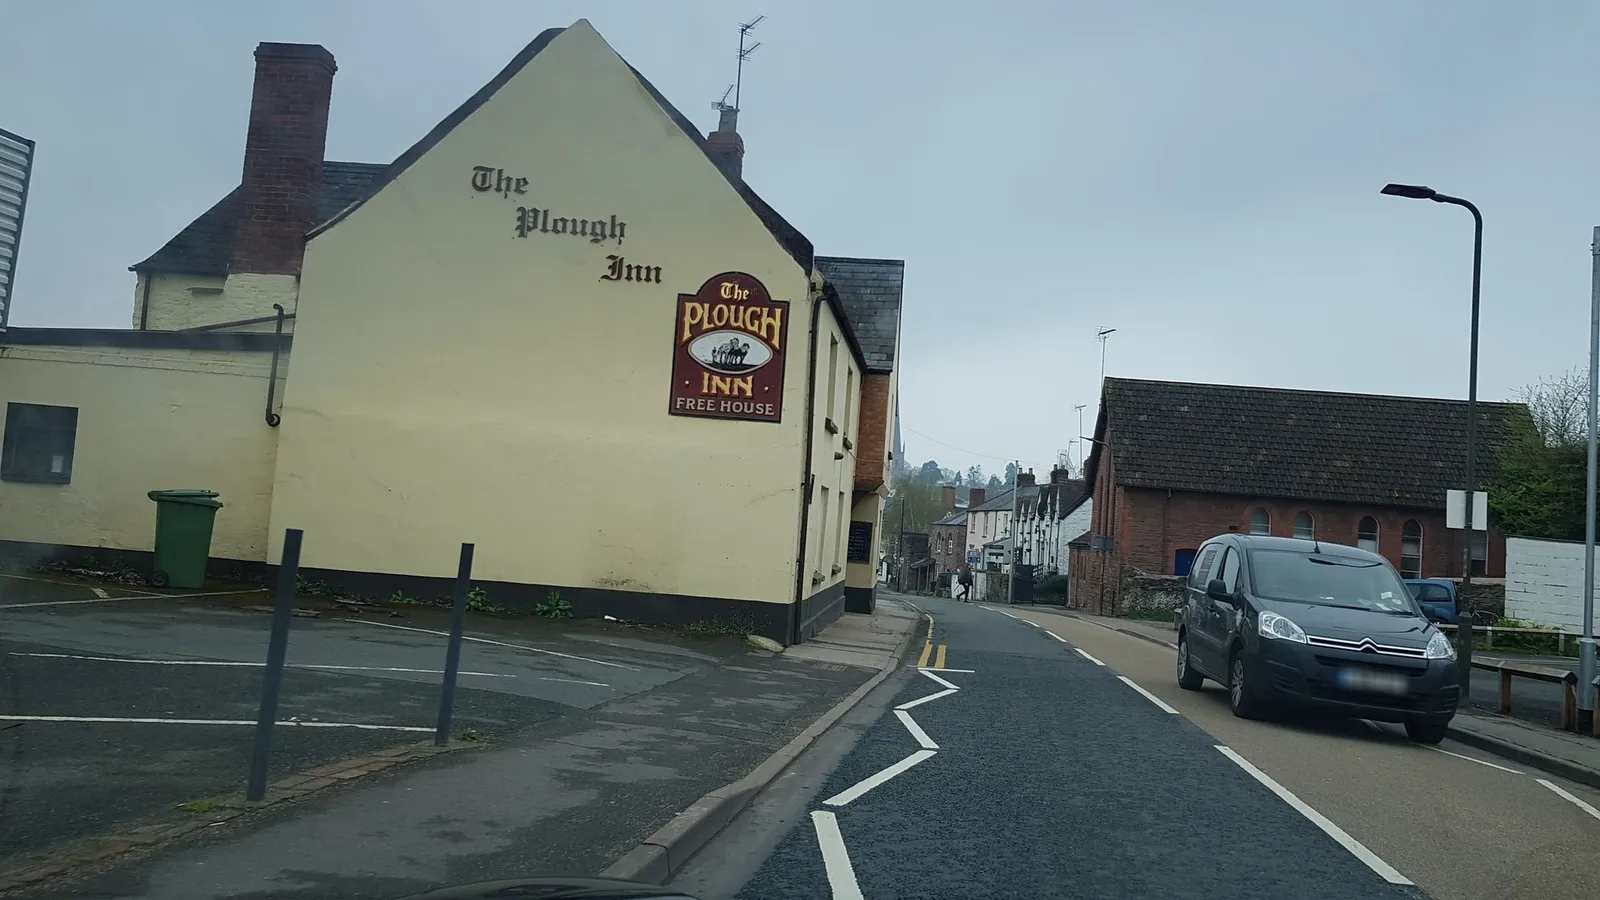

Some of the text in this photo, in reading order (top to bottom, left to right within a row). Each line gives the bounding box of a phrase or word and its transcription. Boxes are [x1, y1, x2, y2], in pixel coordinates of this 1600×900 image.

[472, 166, 529, 198] The
[515, 206, 627, 245] Plough
[601, 254, 662, 284] Inn
[720, 282, 749, 301] The
[682, 302, 782, 349] PLOUGH
[702, 372, 753, 397] INN
[676, 397, 775, 415] FREE HOUSE
